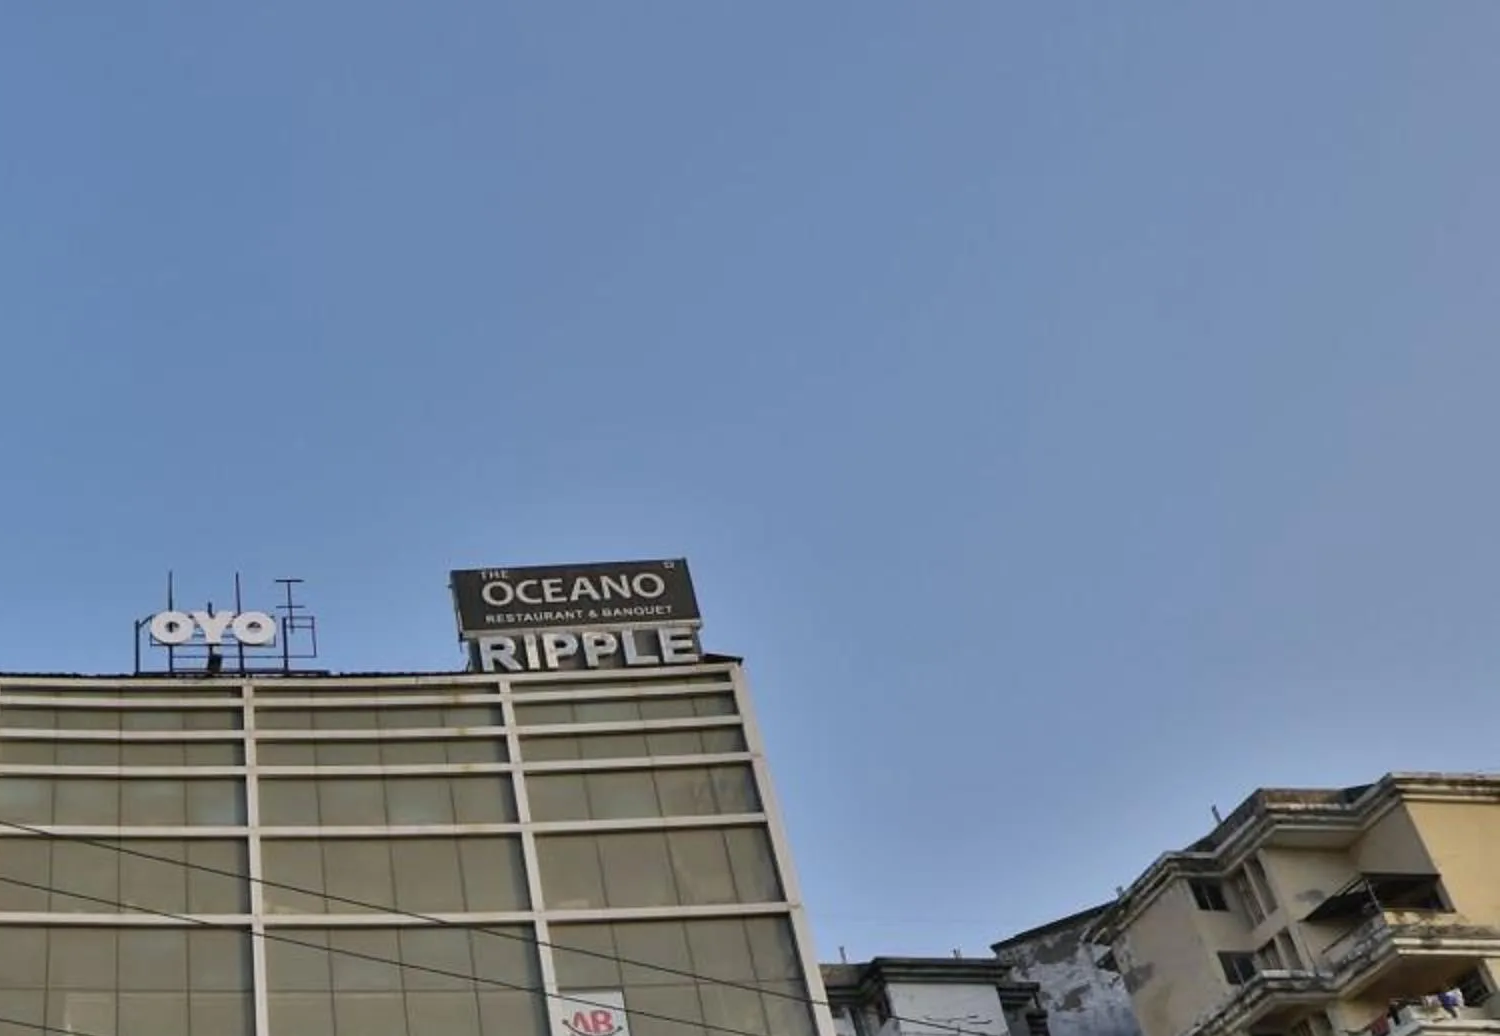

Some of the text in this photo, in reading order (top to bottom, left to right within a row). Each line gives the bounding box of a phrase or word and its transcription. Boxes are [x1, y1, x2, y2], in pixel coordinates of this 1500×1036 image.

[481, 570, 509, 580] THE
[481, 573, 665, 606] OCEANO
[151, 611, 276, 644] OYO
[486, 605, 673, 624] RESTAURANT & BANQUET
[479, 626, 699, 672] RIPPLE
